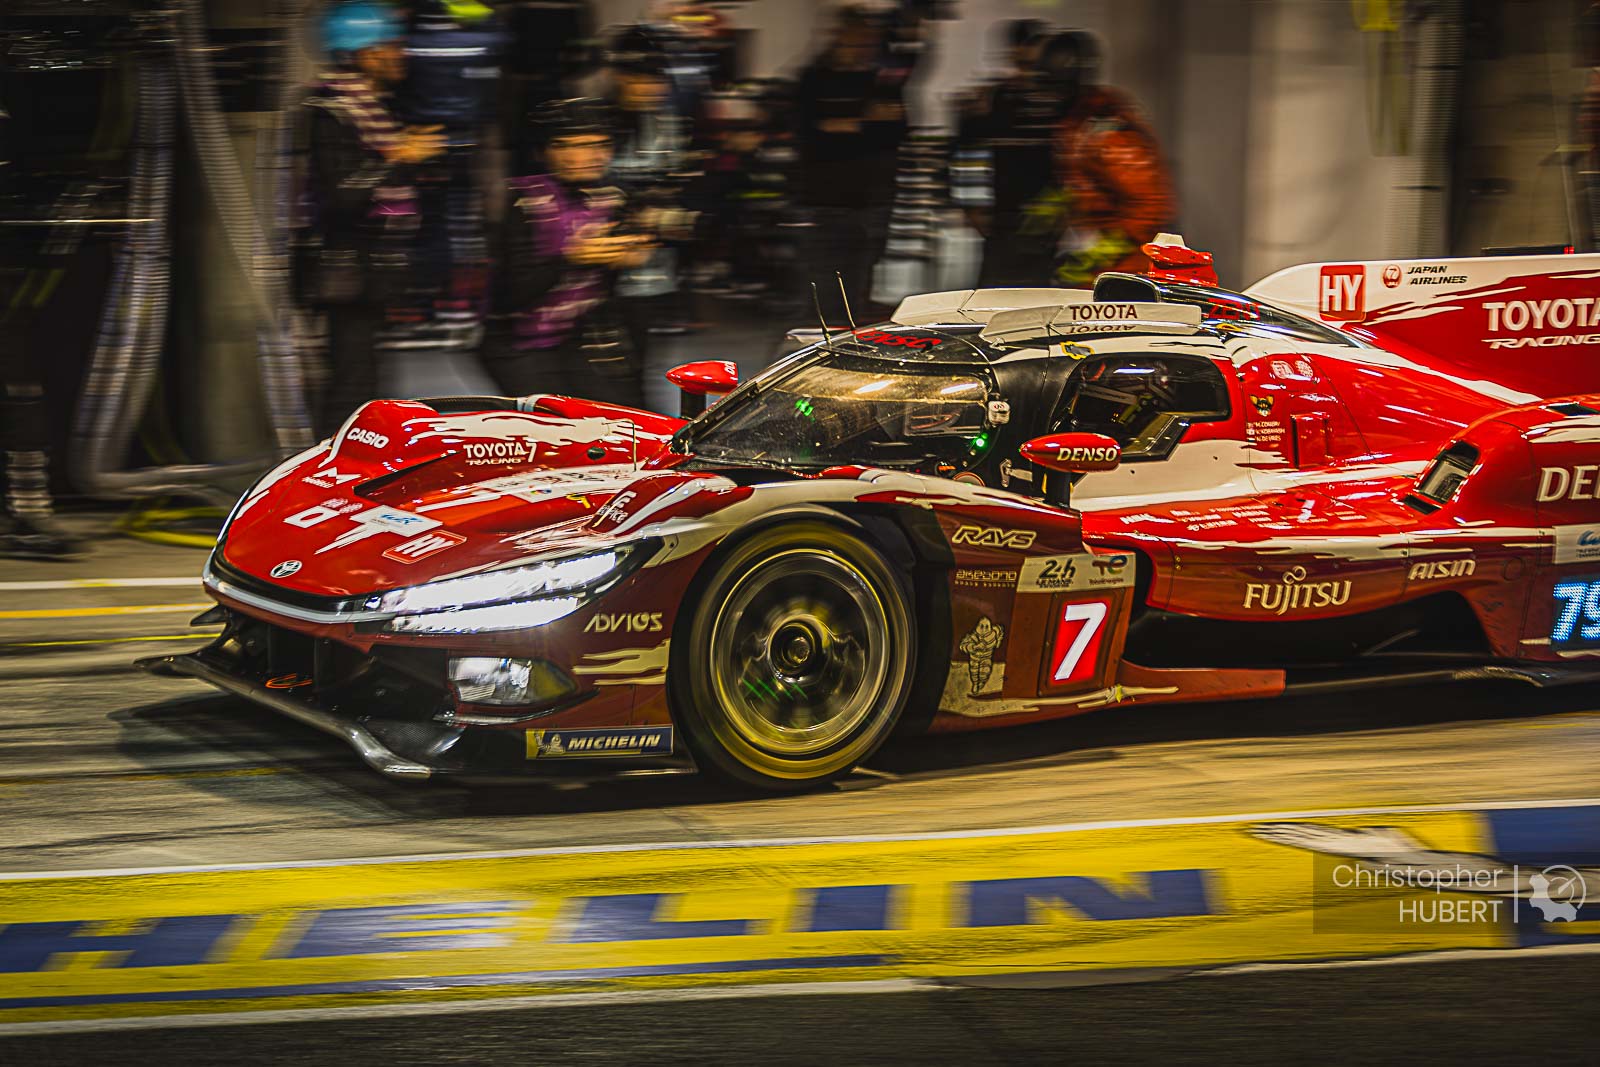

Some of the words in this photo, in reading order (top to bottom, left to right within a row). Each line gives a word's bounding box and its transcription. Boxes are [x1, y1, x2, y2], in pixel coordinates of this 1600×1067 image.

[1407, 265, 1448, 274] JAPAN
[1410, 275, 1468, 285] AIRLINES
[1321, 274, 1364, 312] HY
[1069, 304, 1138, 320] TOYOTA
[346, 427, 389, 449] CASIO
[463, 442, 525, 458] TOYOTA
[1056, 447, 1118, 462] DENSO
[1536, 465, 1600, 502] DE
[952, 525, 1037, 549] RAYS
[1408, 559, 1477, 581] AISIN
[1243, 580, 1353, 616] FUJITSU
[1054, 602, 1107, 680] 7
[567, 733, 662, 751] MICHELIN
